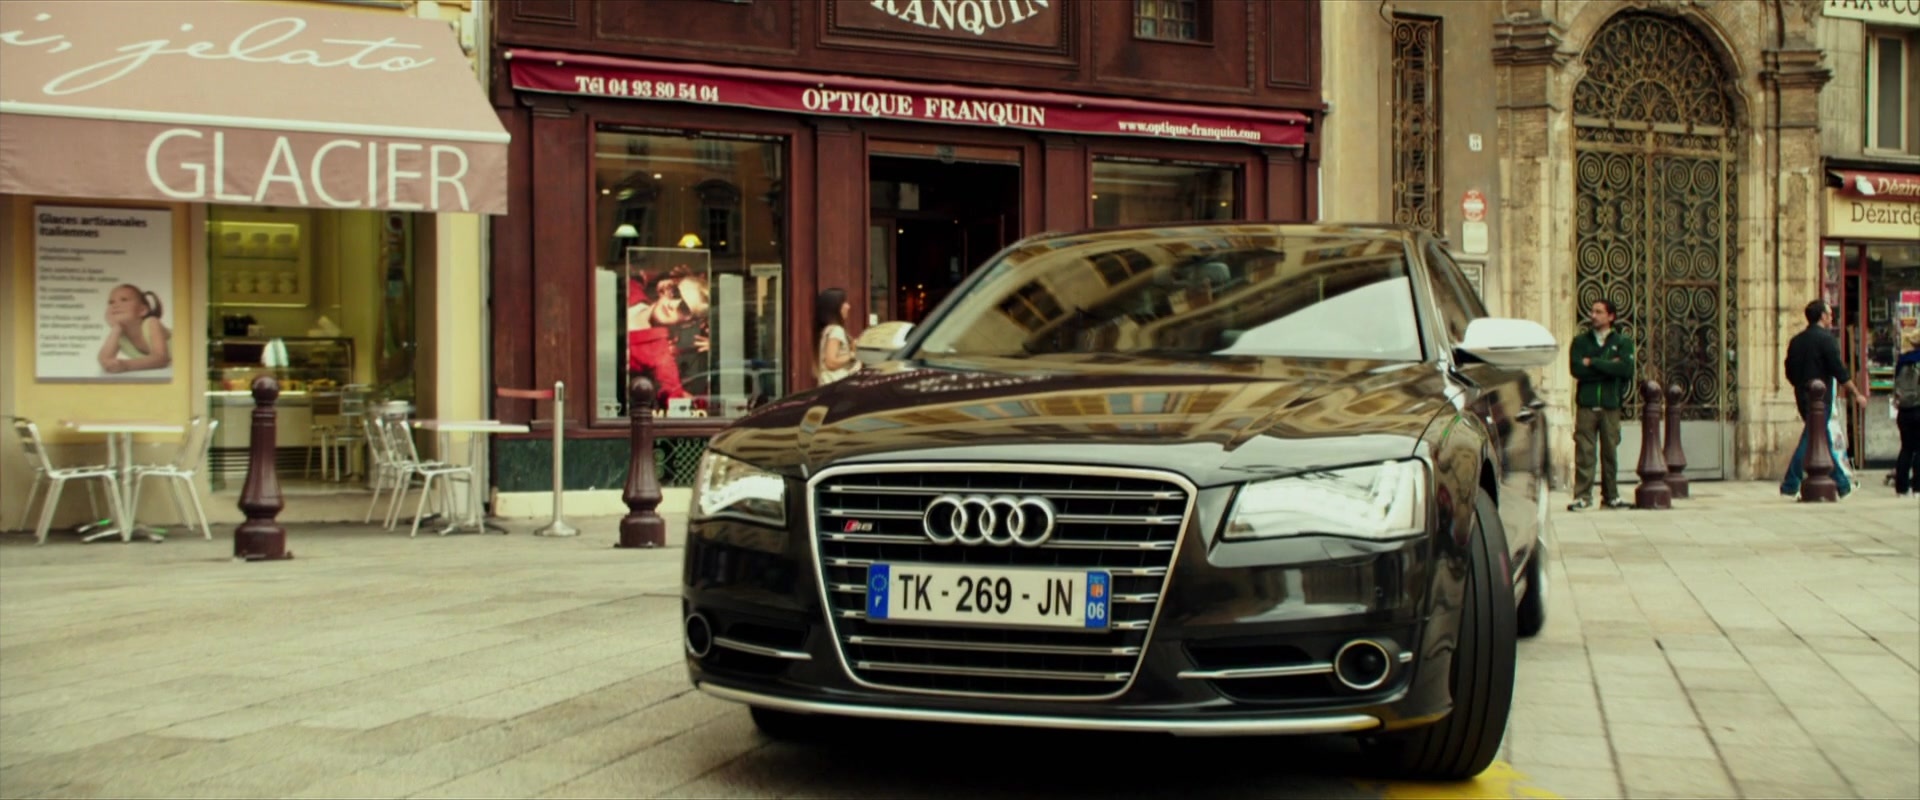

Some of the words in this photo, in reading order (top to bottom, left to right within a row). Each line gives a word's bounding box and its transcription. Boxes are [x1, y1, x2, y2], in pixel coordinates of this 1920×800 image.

[575, 76, 605, 94] Tél
[608, 79, 628, 96] 04
[632, 80, 652, 97] 93
[655, 82, 675, 98] 80
[679, 83, 697, 100] 54
[700, 85, 719, 102] 04
[801, 88, 914, 117] OPTIQUE
[924, 97, 1046, 127] FRANQUIN
[1118, 121, 1261, 140] www.optique-franquin.com
[145, 127, 470, 212] GLACIER
[1087, 601, 1106, 621] 06
